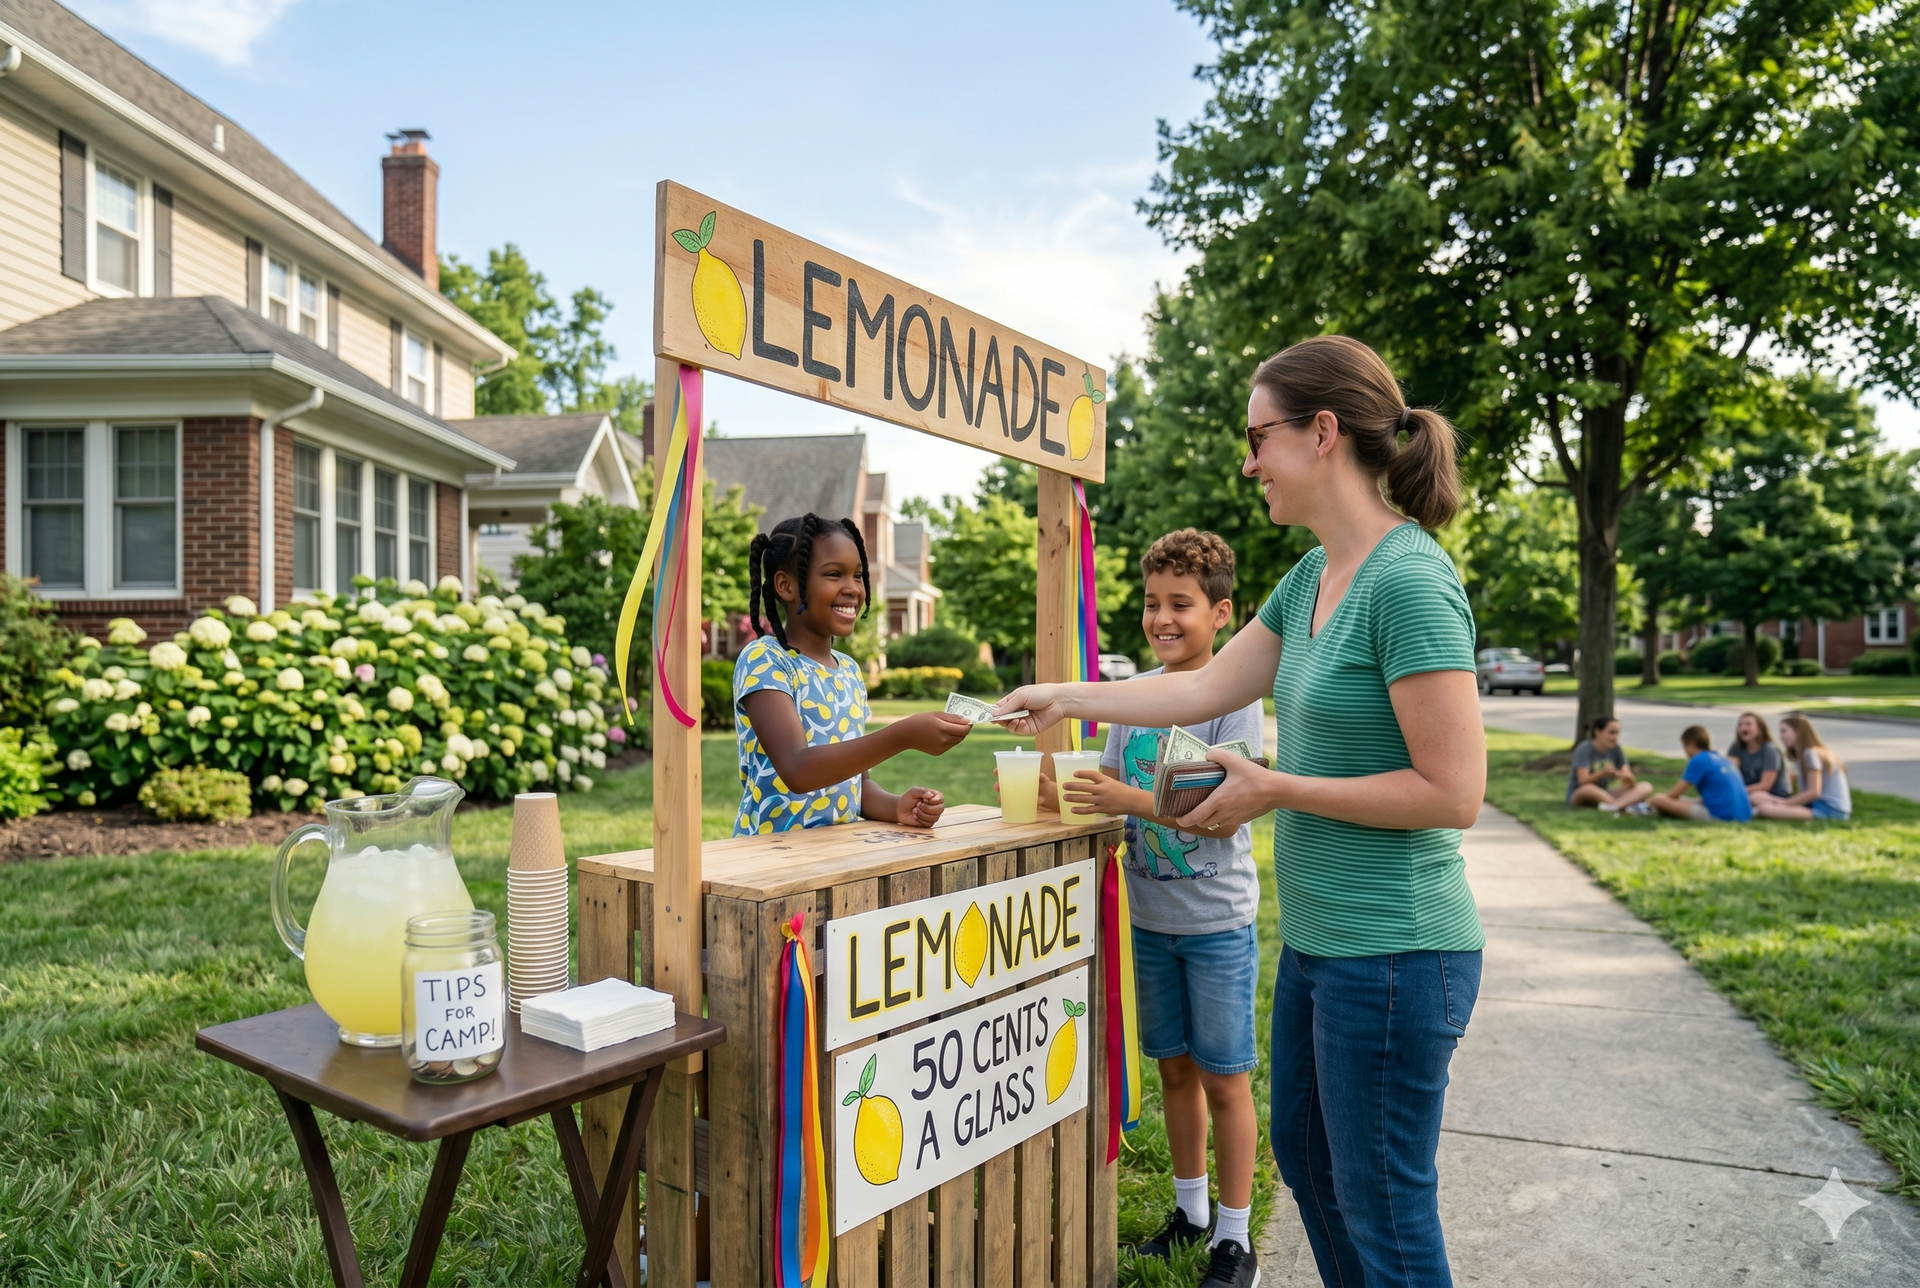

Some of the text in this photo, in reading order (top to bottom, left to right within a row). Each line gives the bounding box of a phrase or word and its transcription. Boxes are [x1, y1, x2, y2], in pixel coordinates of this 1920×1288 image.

[752, 238, 1066, 457] LEMONADE
[422, 974, 486, 1002] TIPS
[445, 1005, 475, 1022] FOR
[425, 1017, 496, 1052] CAMP!
[911, 996, 1049, 1101] 50 CENTS
[915, 1065, 1035, 1171] A GLASS
